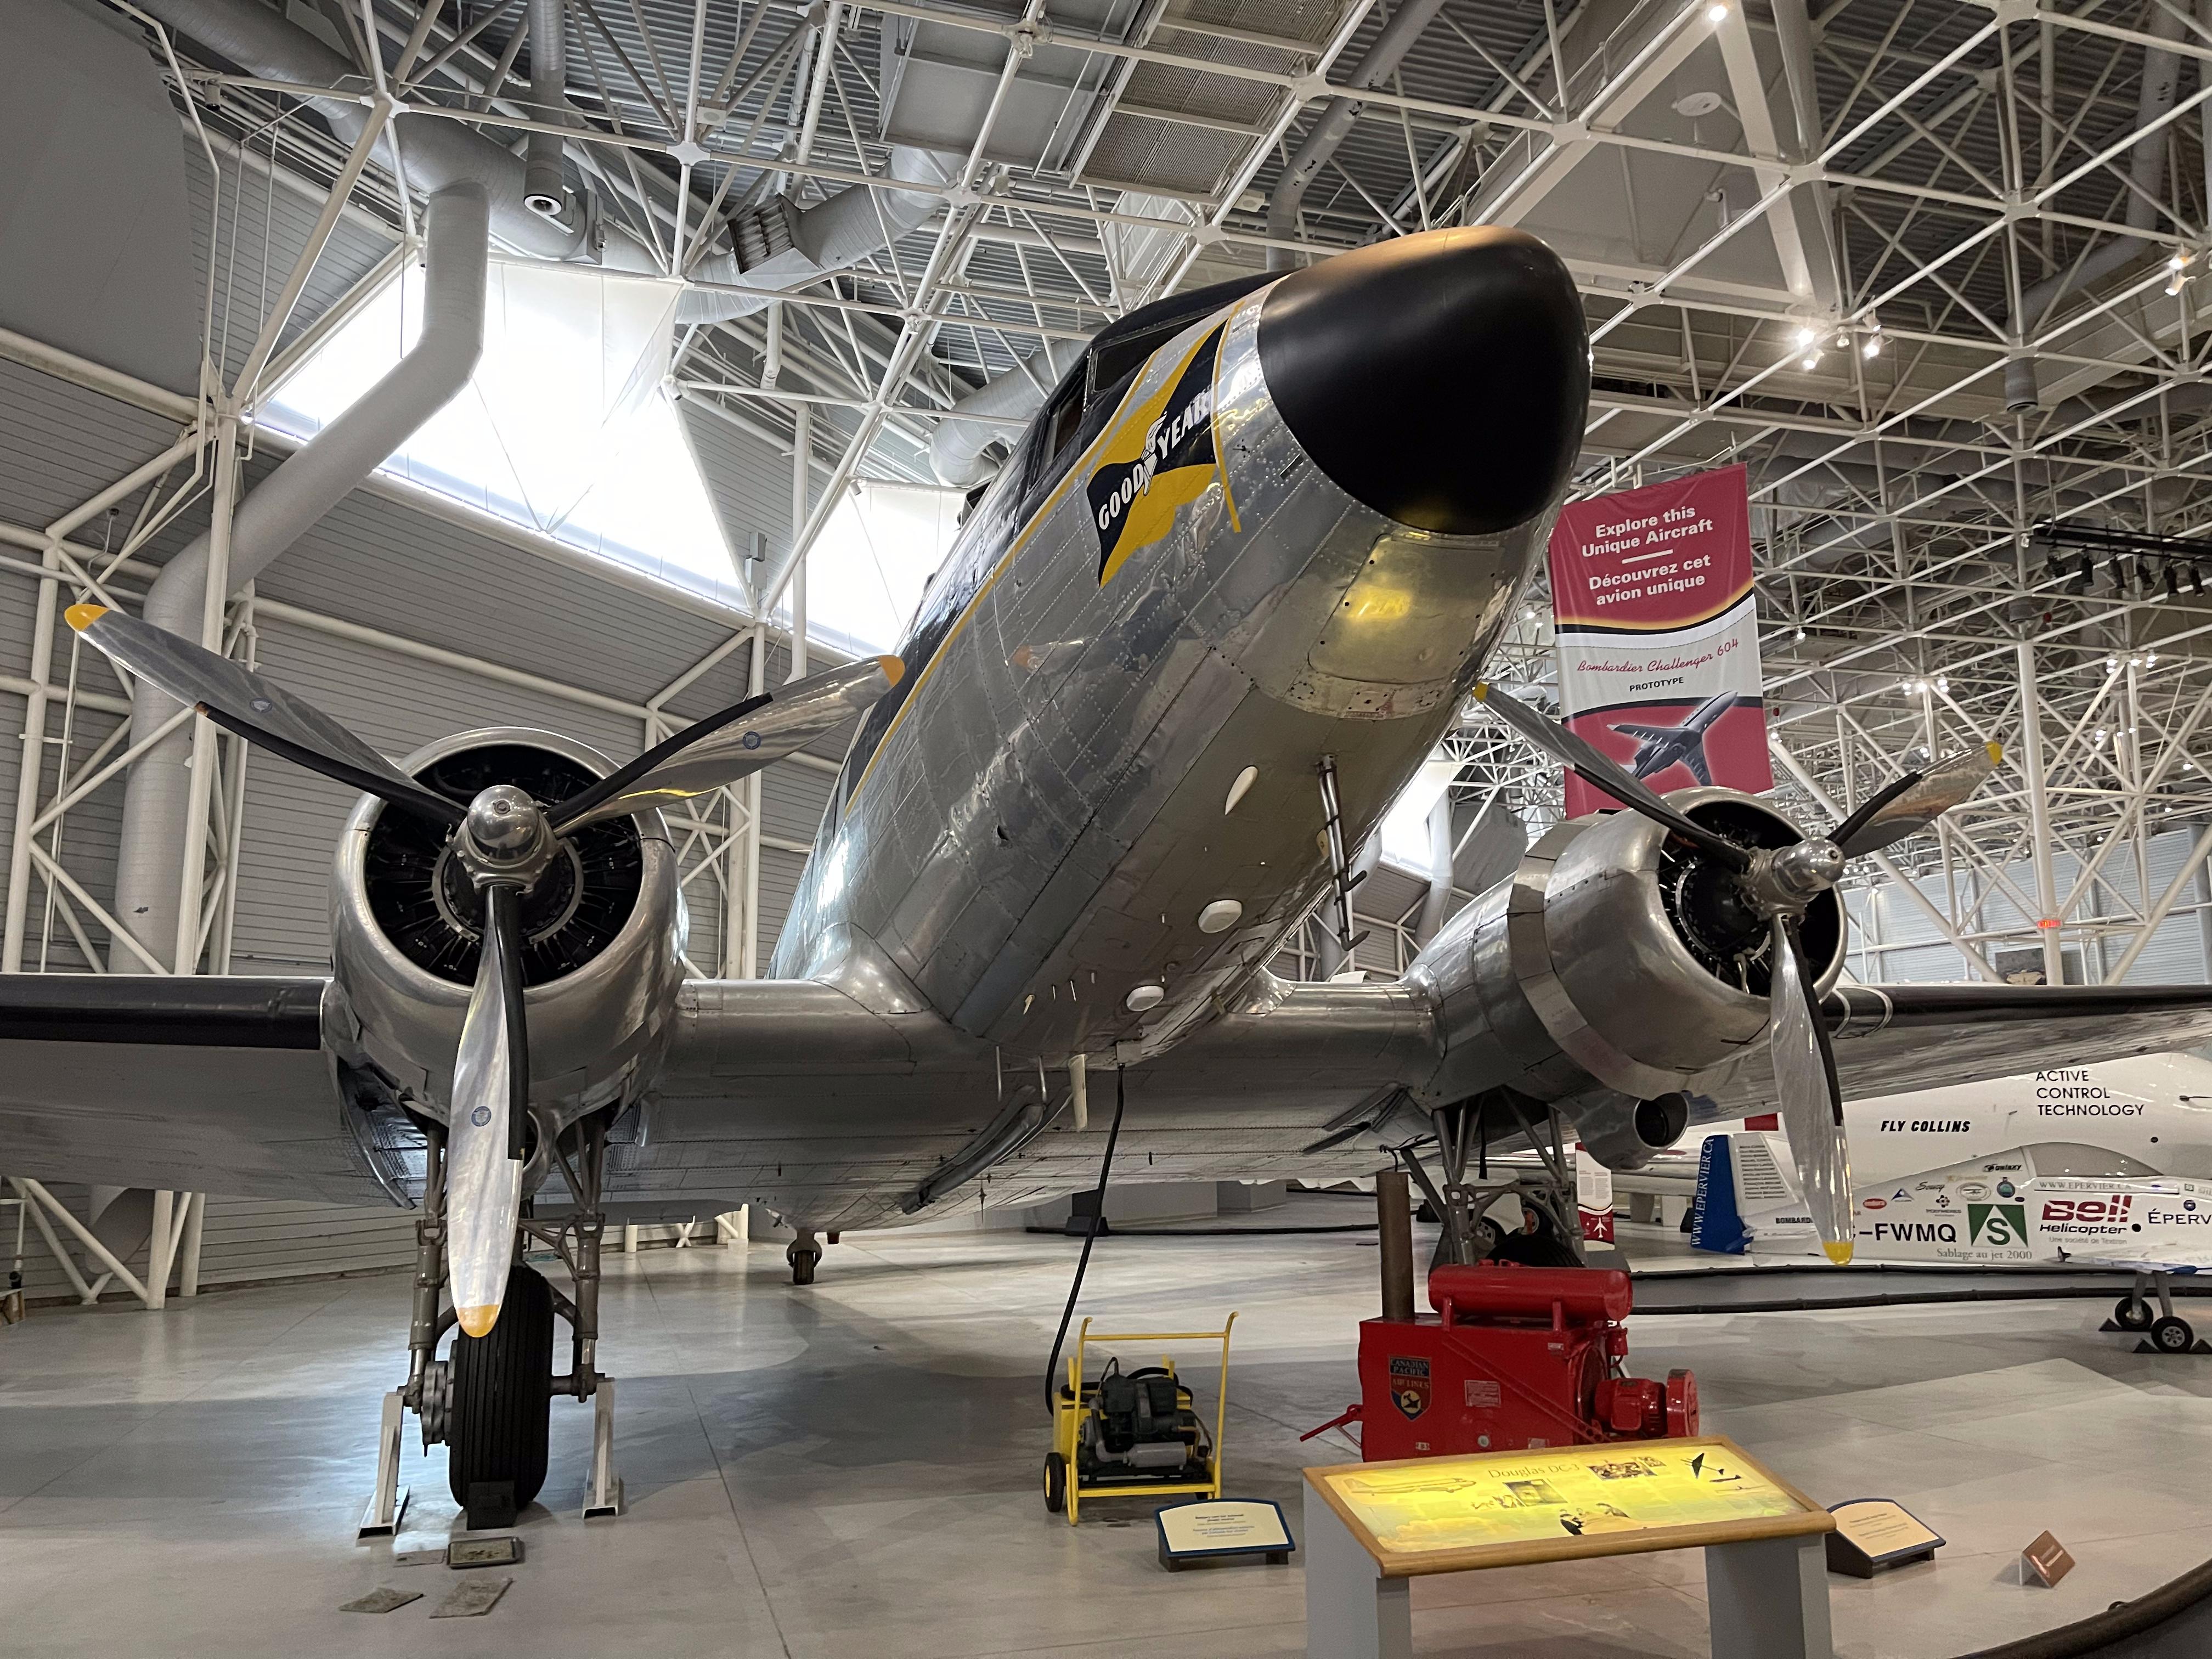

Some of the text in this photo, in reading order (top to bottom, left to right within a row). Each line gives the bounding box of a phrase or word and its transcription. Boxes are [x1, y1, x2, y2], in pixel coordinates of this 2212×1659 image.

[1596, 506, 1695, 538] Explore this
[1582, 518, 1713, 557] Unique Aircraft
[1589, 555, 1711, 590] Découvrez cet
[1596, 575, 1705, 605] avion unique
[1577, 638, 1739, 672] Bombardier Challenger 604
[1629, 676, 1684, 692] PROTOTYPE
[2036, 1070, 2089, 1081] ACTIVE
[2036, 1087, 2110, 1098] CONTROL
[2038, 1104, 2144, 1116] TECHNOLOGY
[1881, 1120, 1971, 1132] FLY COLLINS
[1691, 1138, 1714, 1245] WWW.EPERVIER.CA
[2042, 1194, 2132, 1222] Bell
[1853, 1223, 1957, 1243] -FWMQ
[1987, 1217, 2011, 1245] S
[2039, 1223, 2128, 1235] Helicopter
[1937, 1248, 1973, 1260] Sablage
[1990, 1250, 2004, 1260] jet
[2006, 1250, 2033, 1260] 2000
[1488, 1463, 1580, 1478] Douglas DC-3
